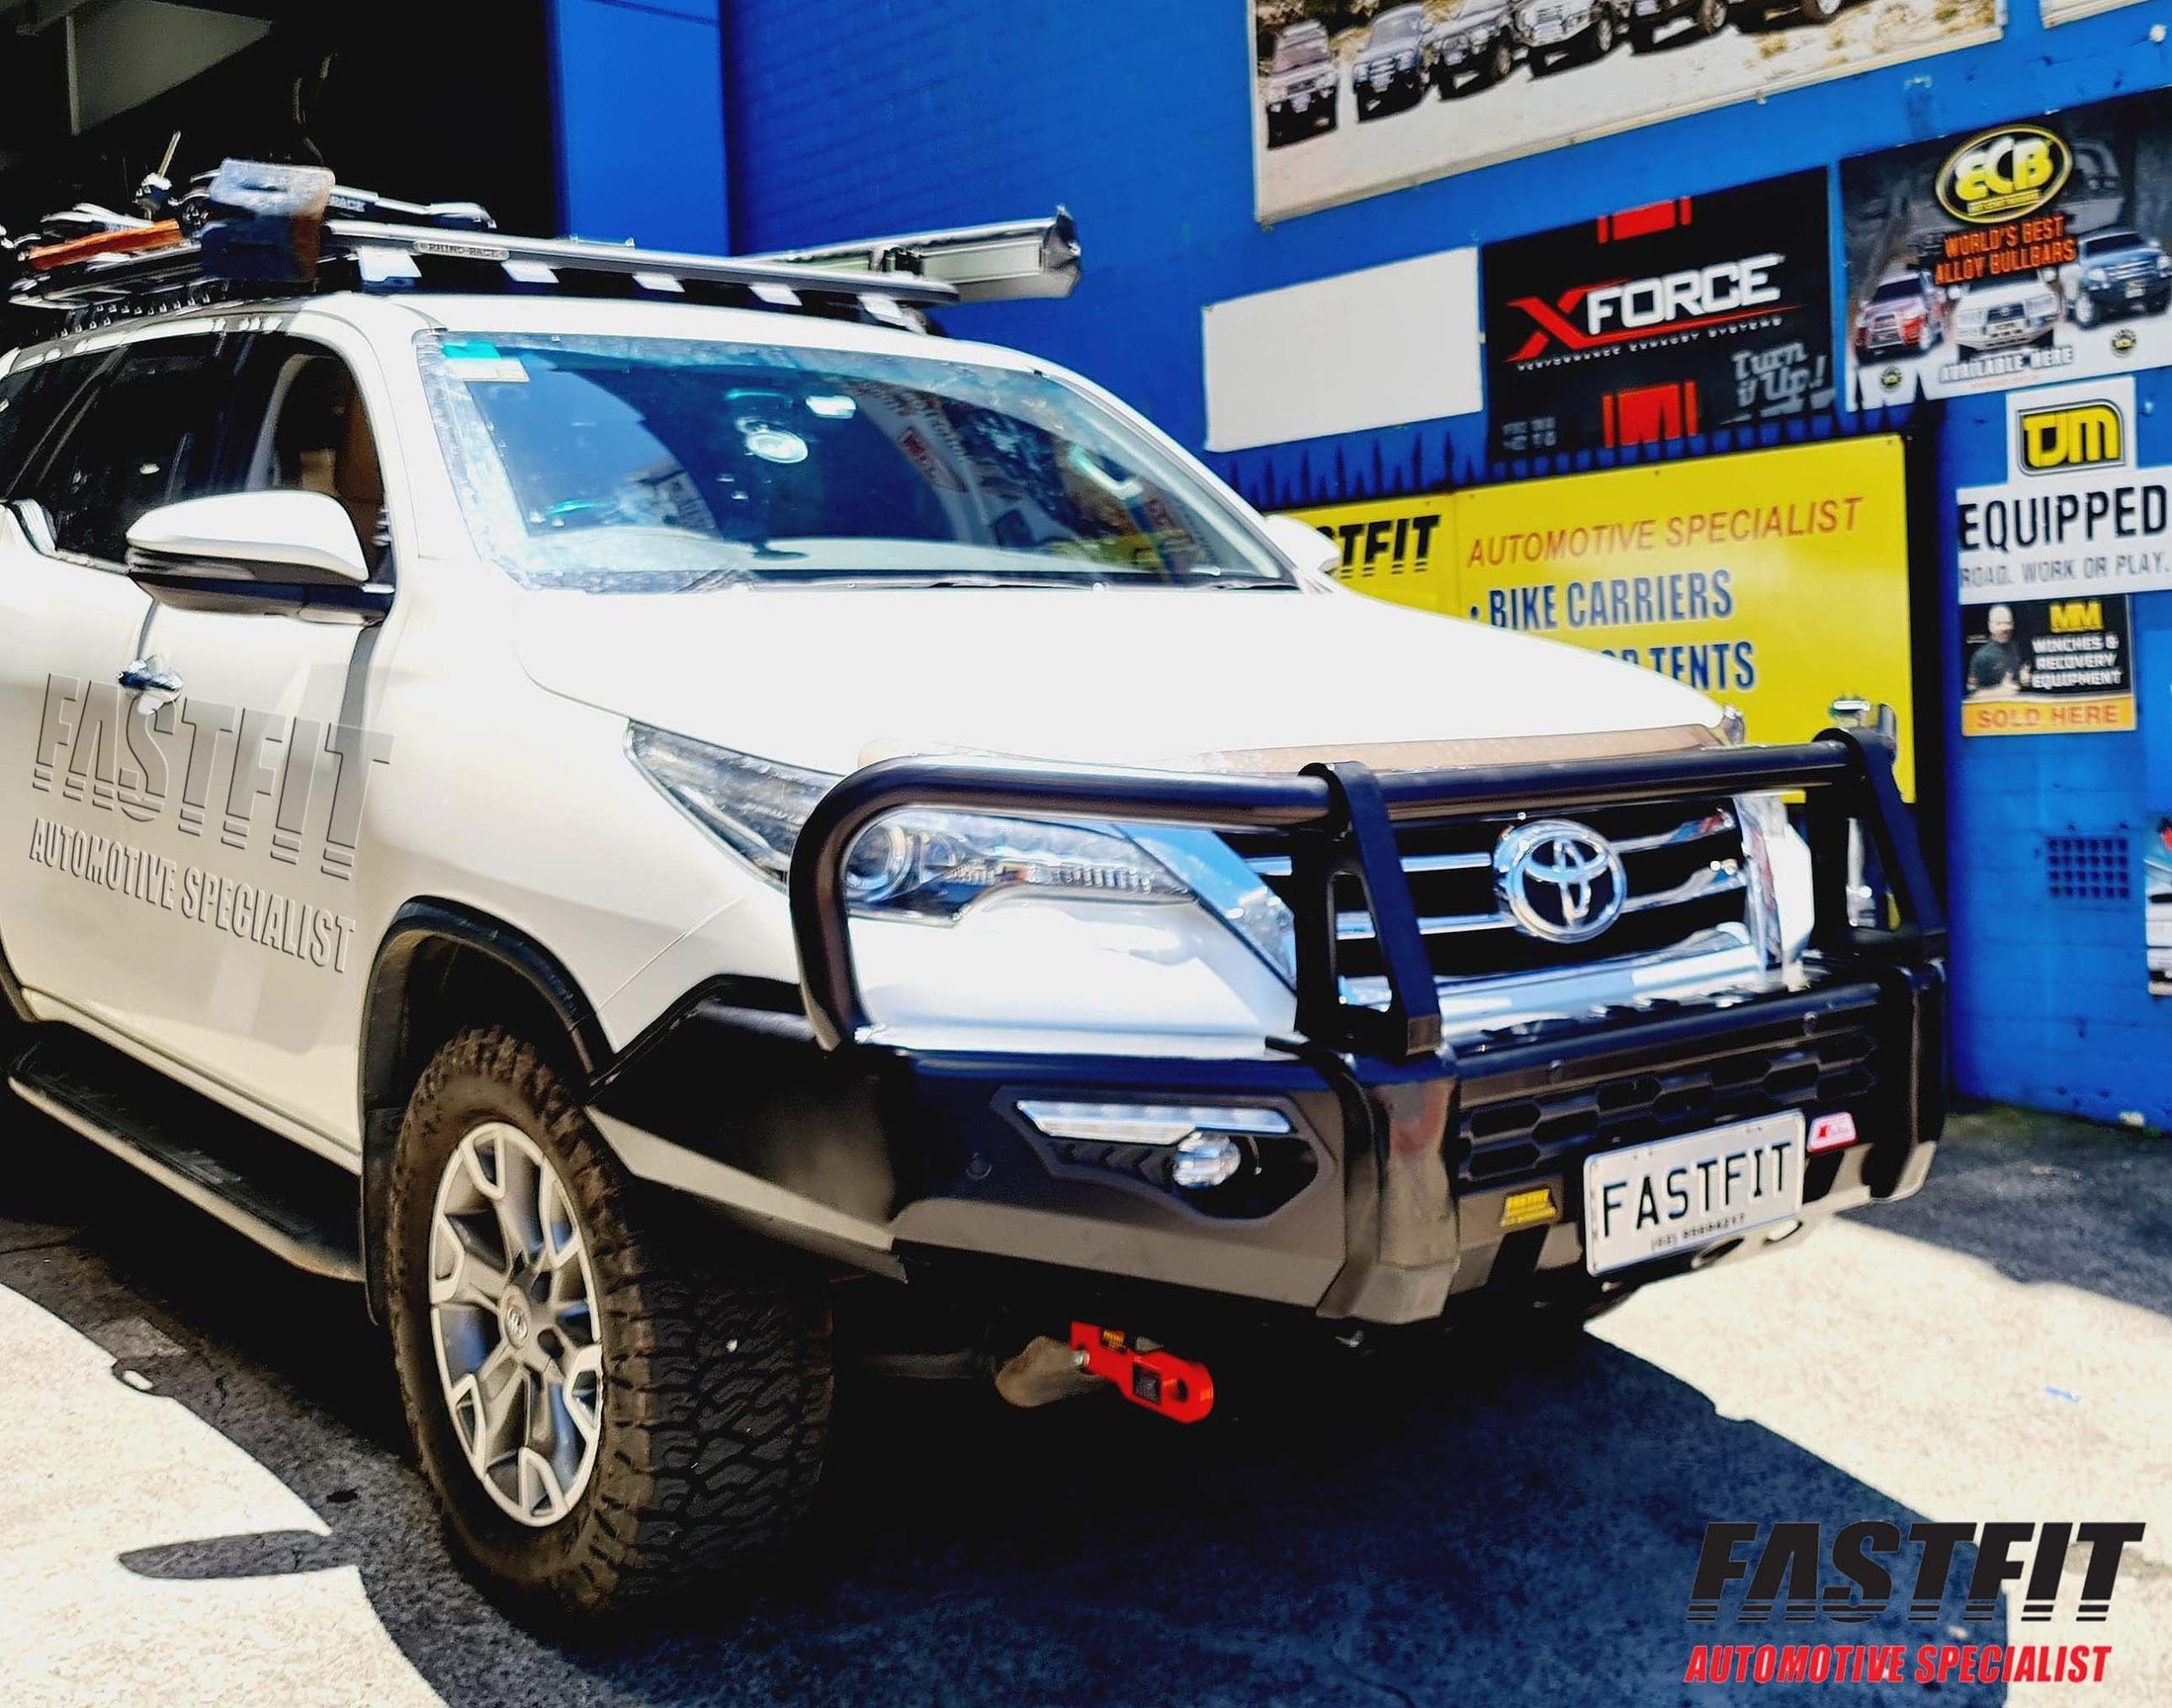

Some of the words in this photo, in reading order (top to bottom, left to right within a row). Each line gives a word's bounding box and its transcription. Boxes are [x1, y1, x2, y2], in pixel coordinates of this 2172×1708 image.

[1955, 136, 2055, 201] ECB
[1945, 225, 2018, 259] WORLD'S
[2021, 216, 2065, 244] BEST
[1934, 256, 1986, 286] ALLOY
[1990, 238, 2078, 274] BULLBARS
[1505, 253, 1787, 363] XFORCE
[1732, 342, 1808, 381] Turn
[2030, 344, 2074, 369] HERE
[1467, 518, 1654, 569] AUTOMOTIVE
[1668, 496, 1863, 554] SPECIALIST
[1957, 484, 2169, 552] EQUIPPED
[1316, 514, 1441, 580] TFIT
[2022, 558, 2077, 584] WORK
[2083, 556, 2109, 579] OR
[1489, 585, 1559, 630] BIKE
[1566, 569, 1734, 629] CARRIERS
[1649, 641, 1756, 692] TENTS
[2032, 635, 2103, 654] WINCHES
[2036, 652, 2117, 671] RECOVERY
[2031, 669, 2123, 691] EQUIPMENT
[1978, 707, 2041, 729] SOLD
[2051, 703, 2119, 726] HERE
[1602, 1141, 1792, 1237] FASTFIT
